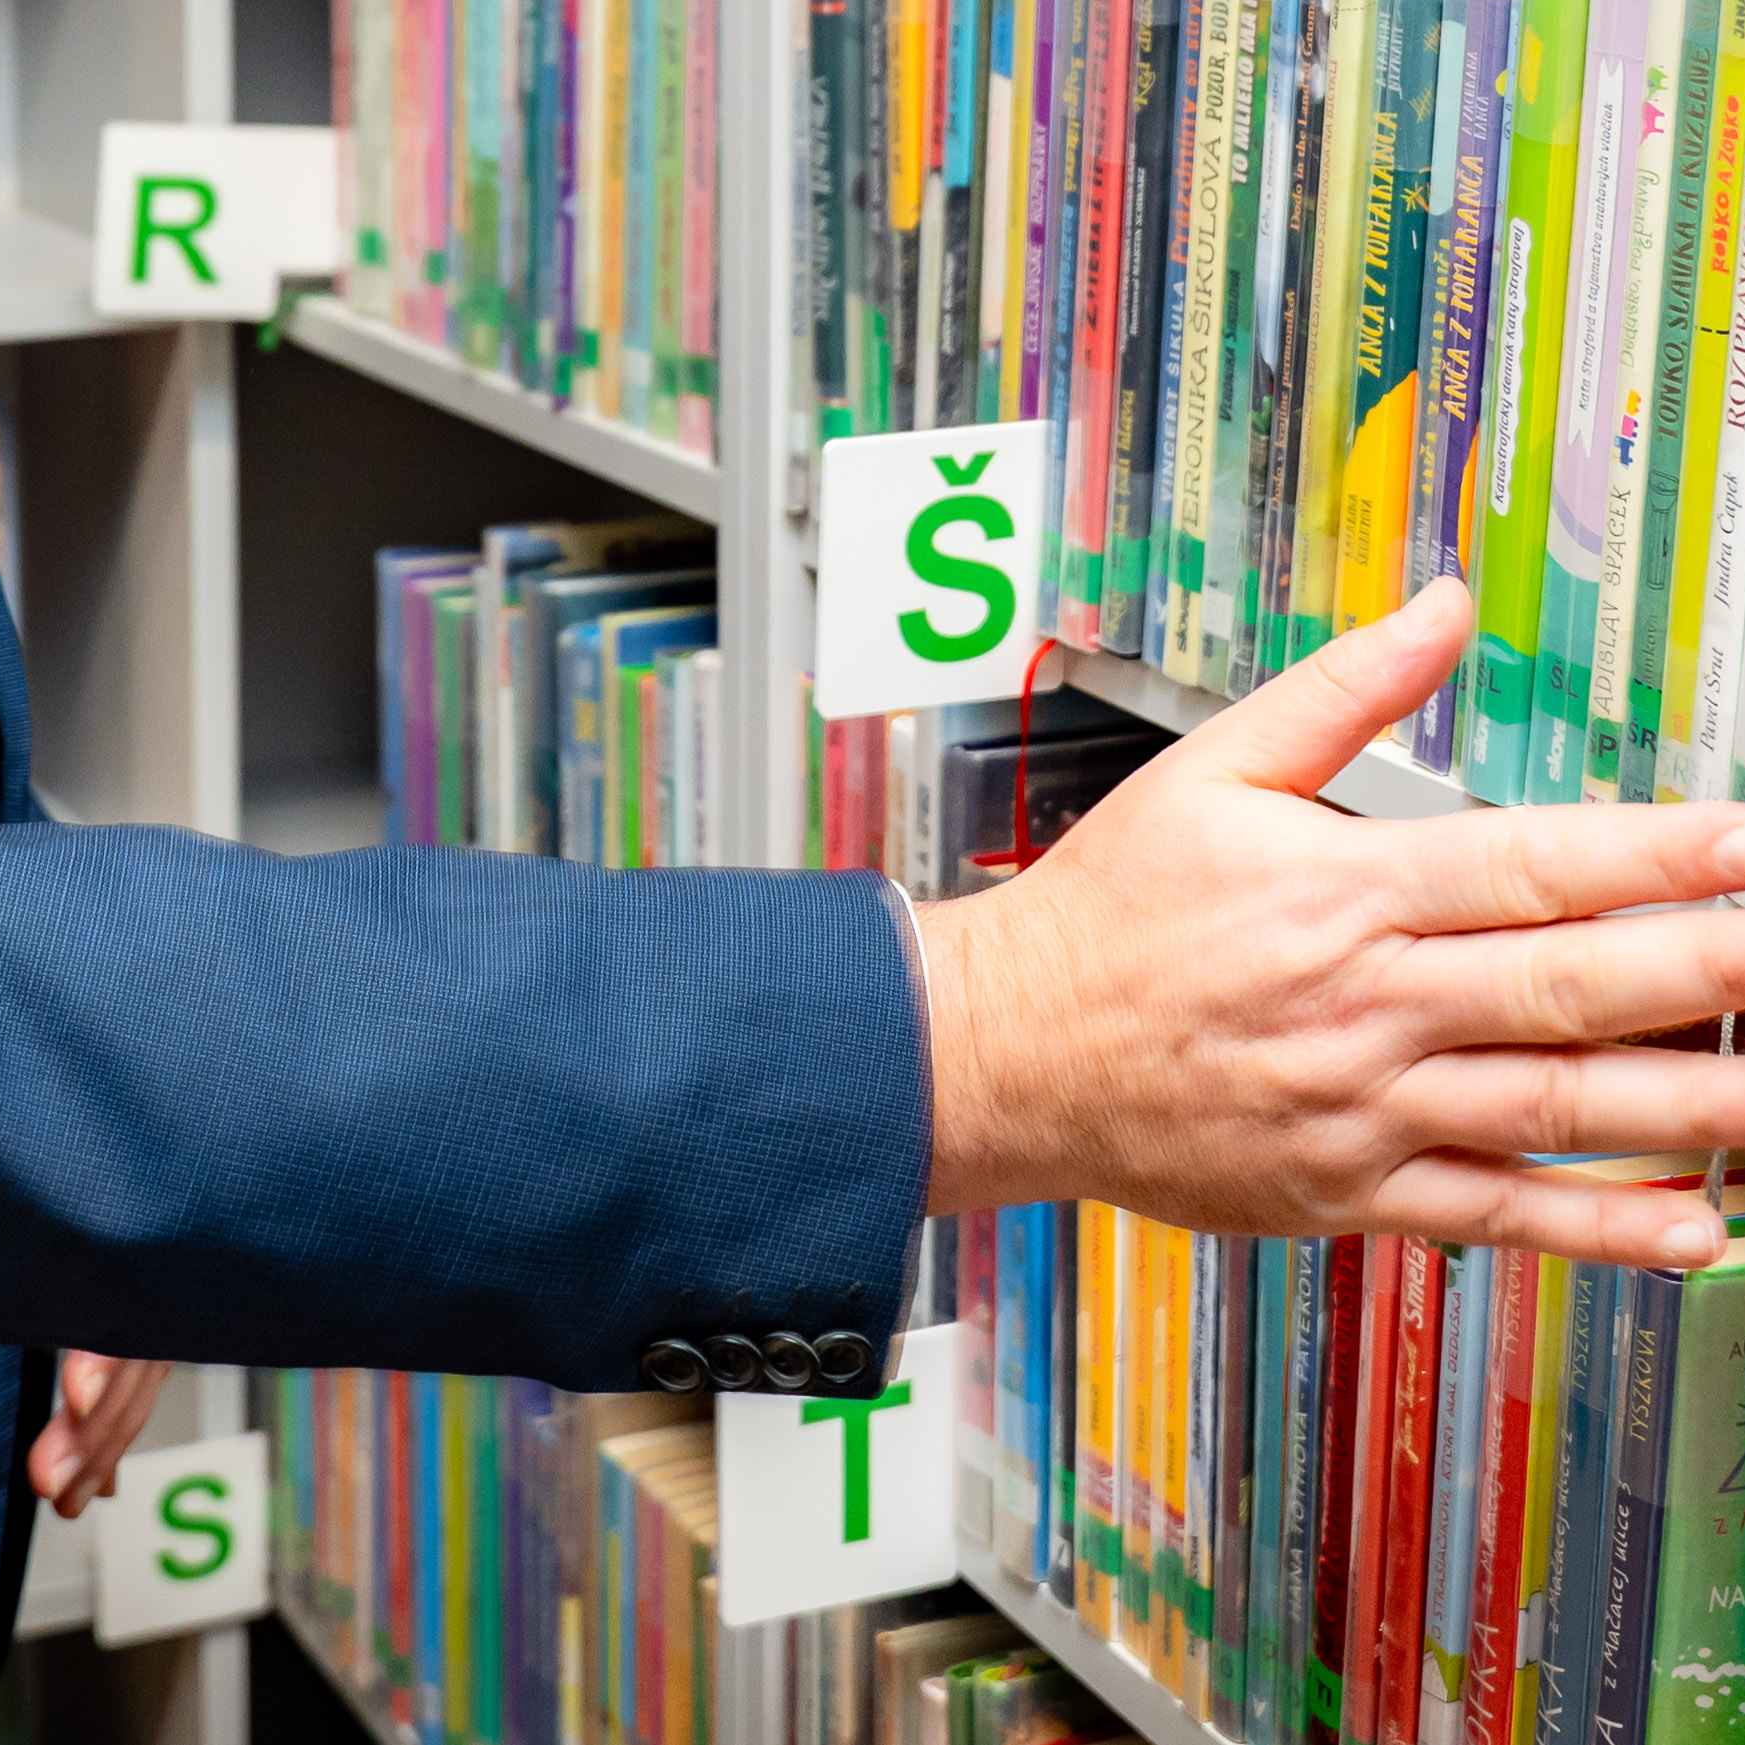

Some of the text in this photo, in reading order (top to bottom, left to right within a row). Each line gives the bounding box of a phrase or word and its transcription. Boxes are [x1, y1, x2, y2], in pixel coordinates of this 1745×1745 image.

[1294, 131, 1306, 158] the
[1296, 81, 1311, 127] Land
[1323, 58, 1338, 119] BICYKLI
[127, 173, 222, 288] R
[1185, 136, 1222, 339] ŠIKULOVÁ
[1206, 51, 1230, 122] POZOR,
[1218, 55, 1255, 423] VERONIKA TO MLIEKO
[1288, 184, 1304, 232] Dodo
[1364, 111, 1398, 270] POMARANČA
[1355, 304, 1385, 377] ANČA
[1363, 273, 1386, 296] Z
[1440, 156, 1484, 422] ANČA Z POMARANČA
[1579, 231, 1605, 412] Kata tajomstvo
[1656, 190, 1699, 441] TONKO, A
[1159, 278, 1186, 503] VINCENT ŠIKULA
[1274, 390, 1291, 449] krajine
[1491, 223, 1525, 504] Katastrofický denník Katy Strofovej
[895, 449, 1019, 665] Š
[1269, 466, 1285, 514] Dodo
[1697, 470, 1741, 754] Pavel Šrut Jindra Čapek
[797, 1378, 914, 1546] T
[1439, 1421, 1456, 1482] KTORÝ
[1443, 1380, 1459, 1419] MAL
[153, 1470, 237, 1583] S
[1287, 1546, 1306, 1622] HANA
[1547, 1452, 1572, 1609] Mačacej ulice
[1602, 1503, 1632, 1668] Mačacej ulice
